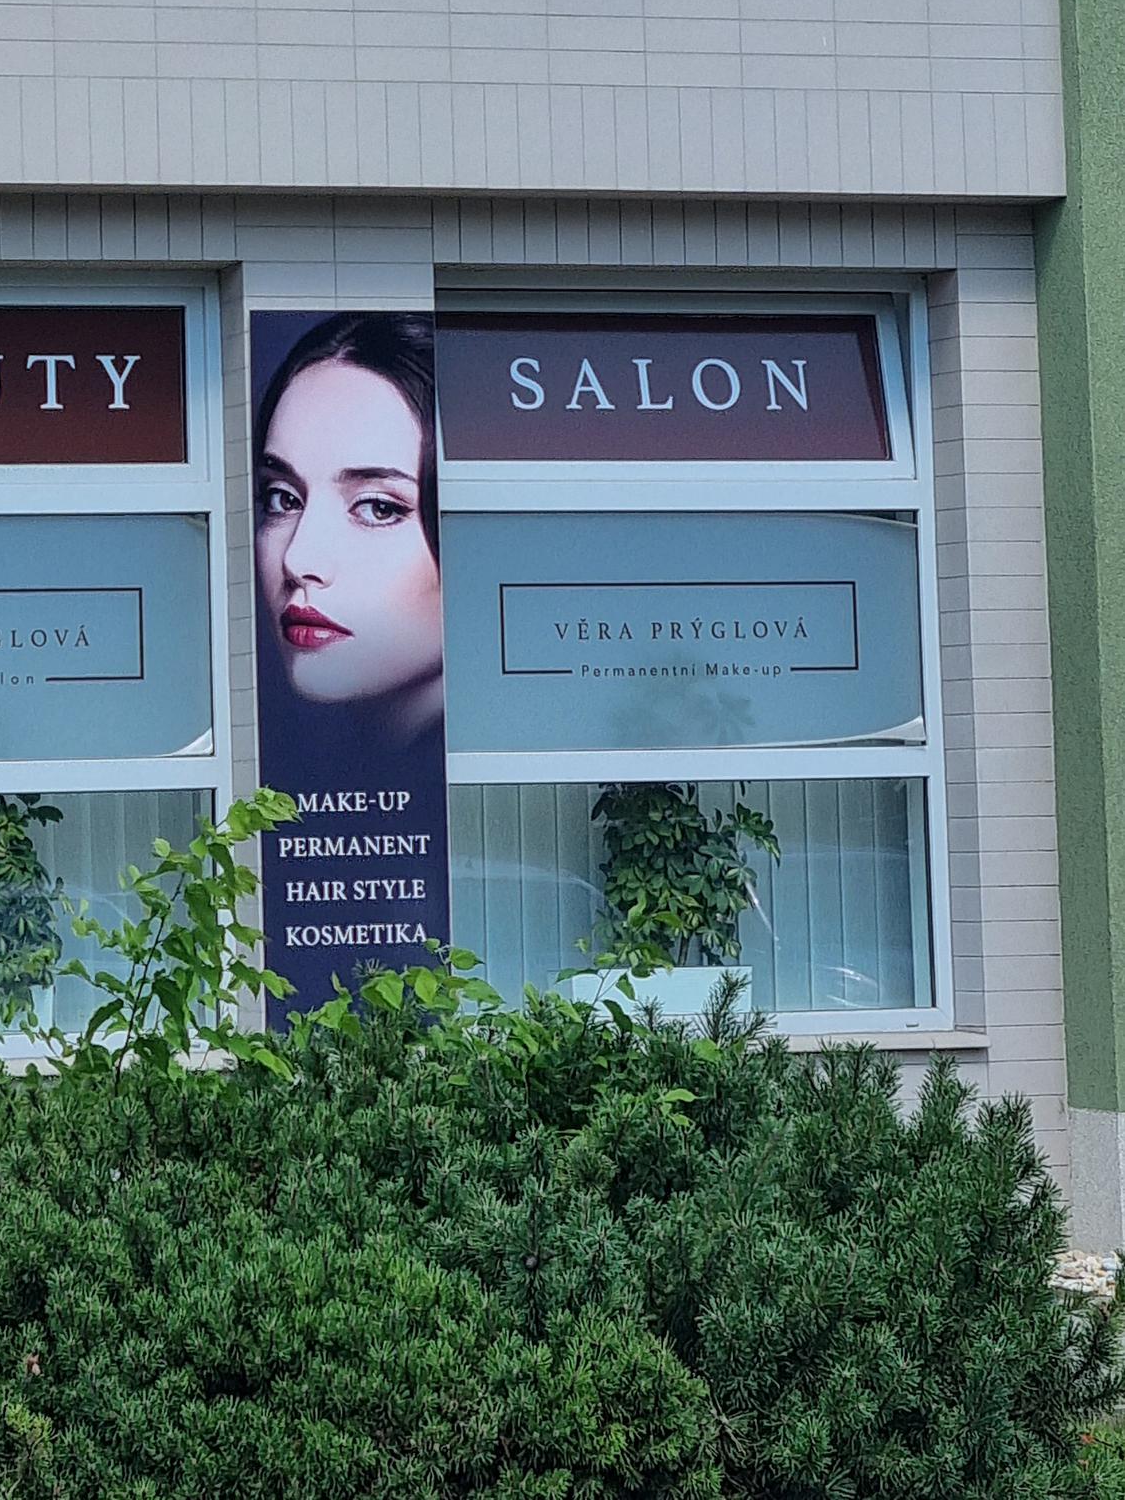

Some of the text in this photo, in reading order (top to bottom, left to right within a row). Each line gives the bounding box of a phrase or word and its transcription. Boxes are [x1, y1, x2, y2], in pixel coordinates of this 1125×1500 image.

[509, 357, 808, 411] SALON
[554, 617, 809, 640] VĚRA PRÝGLOVÁ
[581, 662, 782, 678] Permanentní Make-up
[297, 790, 411, 812] MAKE-UP
[279, 835, 430, 857] PERMANENT
[285, 878, 427, 902] HAIR STYLE
[285, 923, 427, 946] KOSMETIKA
